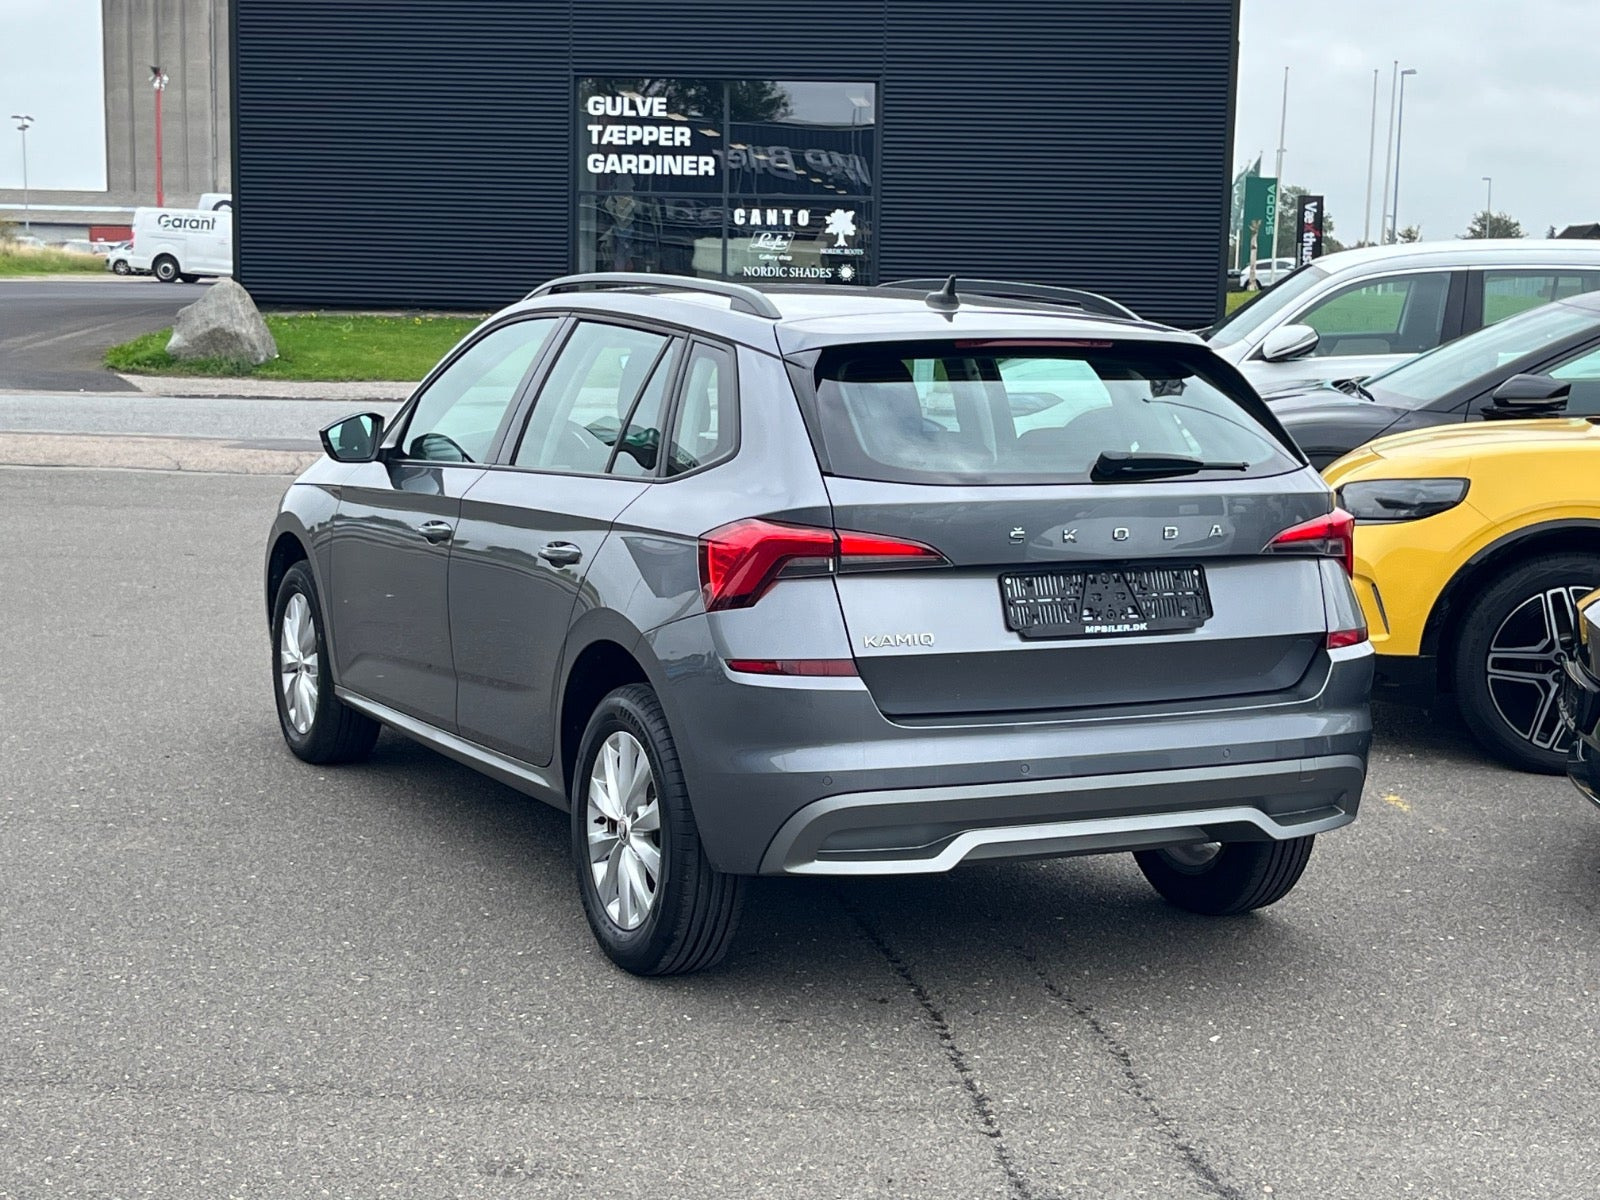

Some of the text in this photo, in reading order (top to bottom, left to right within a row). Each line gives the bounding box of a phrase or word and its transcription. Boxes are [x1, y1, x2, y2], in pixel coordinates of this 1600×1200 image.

[587, 95, 668, 117] GULVE
[587, 125, 691, 146] TÆPPER
[586, 154, 716, 176] GARDINER
[158, 214, 216, 230] Garant
[734, 208, 809, 226] CANTO
[743, 266, 833, 279] NORDIC SHADES
[1008, 524, 1225, 545] ŠKODA
[1084, 622, 1148, 634] MPBILER.DK
[863, 632, 936, 649] KAMIQ
